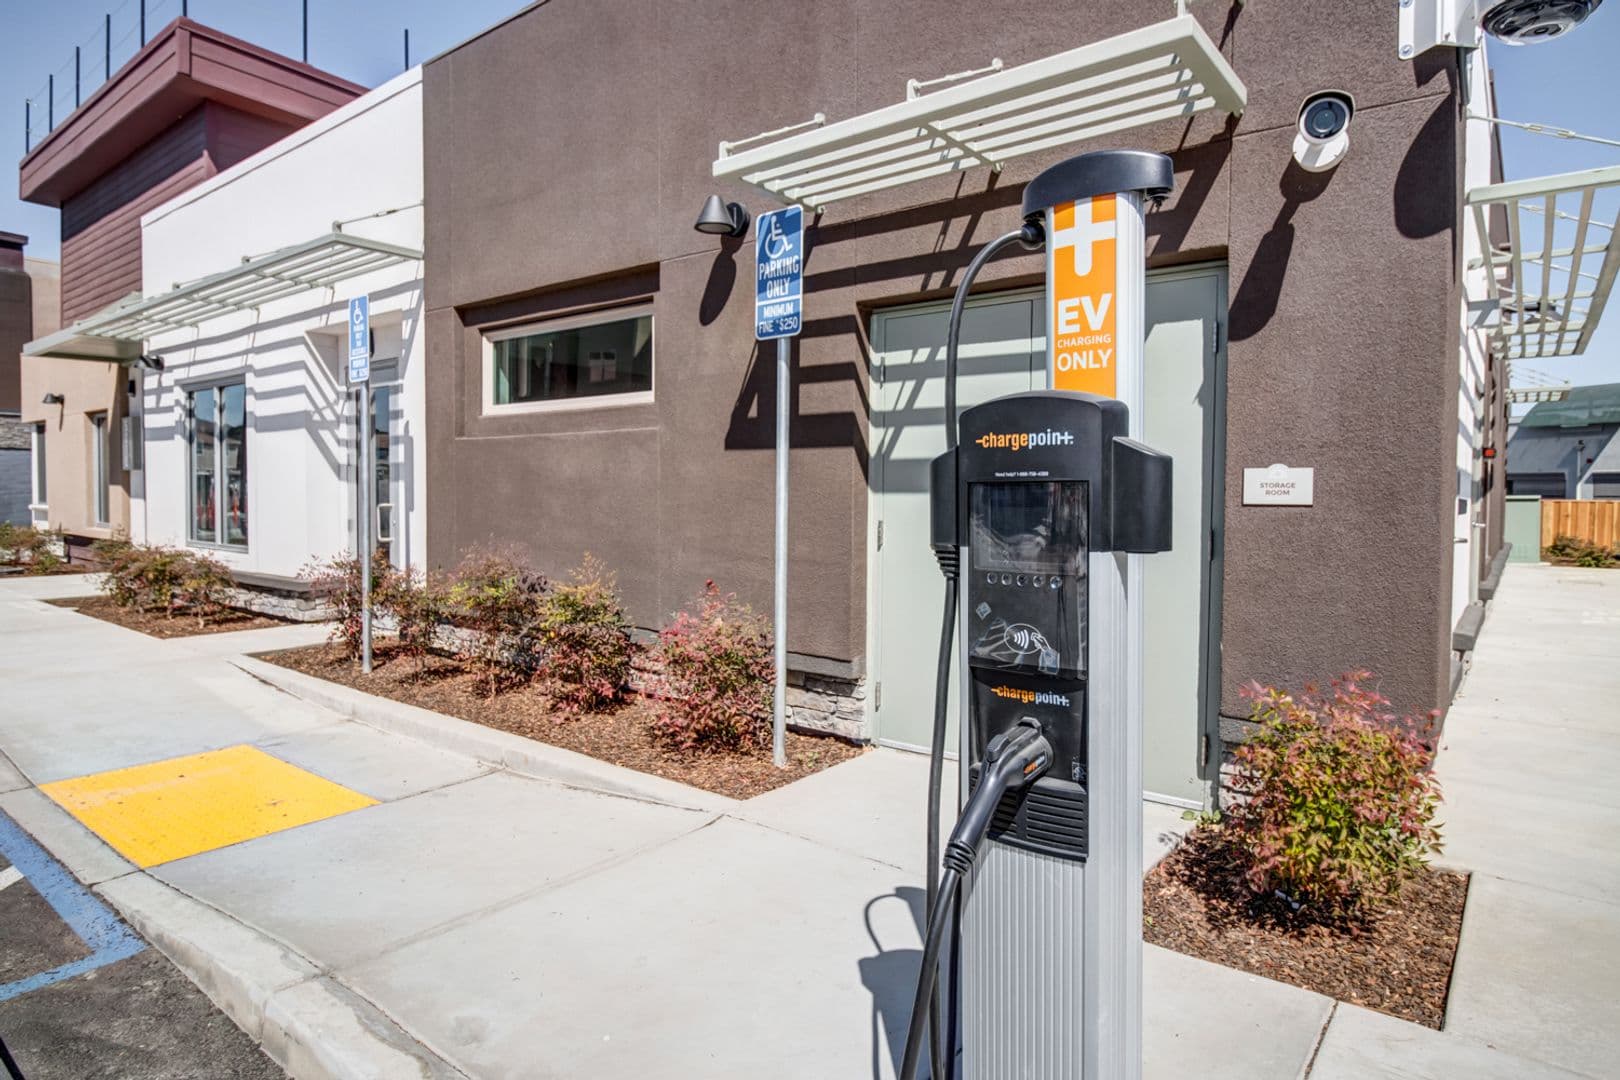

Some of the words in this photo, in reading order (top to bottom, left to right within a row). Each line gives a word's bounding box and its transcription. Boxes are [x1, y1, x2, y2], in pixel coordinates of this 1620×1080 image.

[759, 255, 800, 281] PARKING
[766, 277, 791, 299] ONLY
[763, 302, 794, 318] MINIMUM
[1057, 293, 1113, 335] EV
[759, 321, 774, 334] FINE
[779, 315, 798, 332] $250
[1057, 333, 1113, 348] CHARGING
[1057, 348, 1113, 372] ONLY
